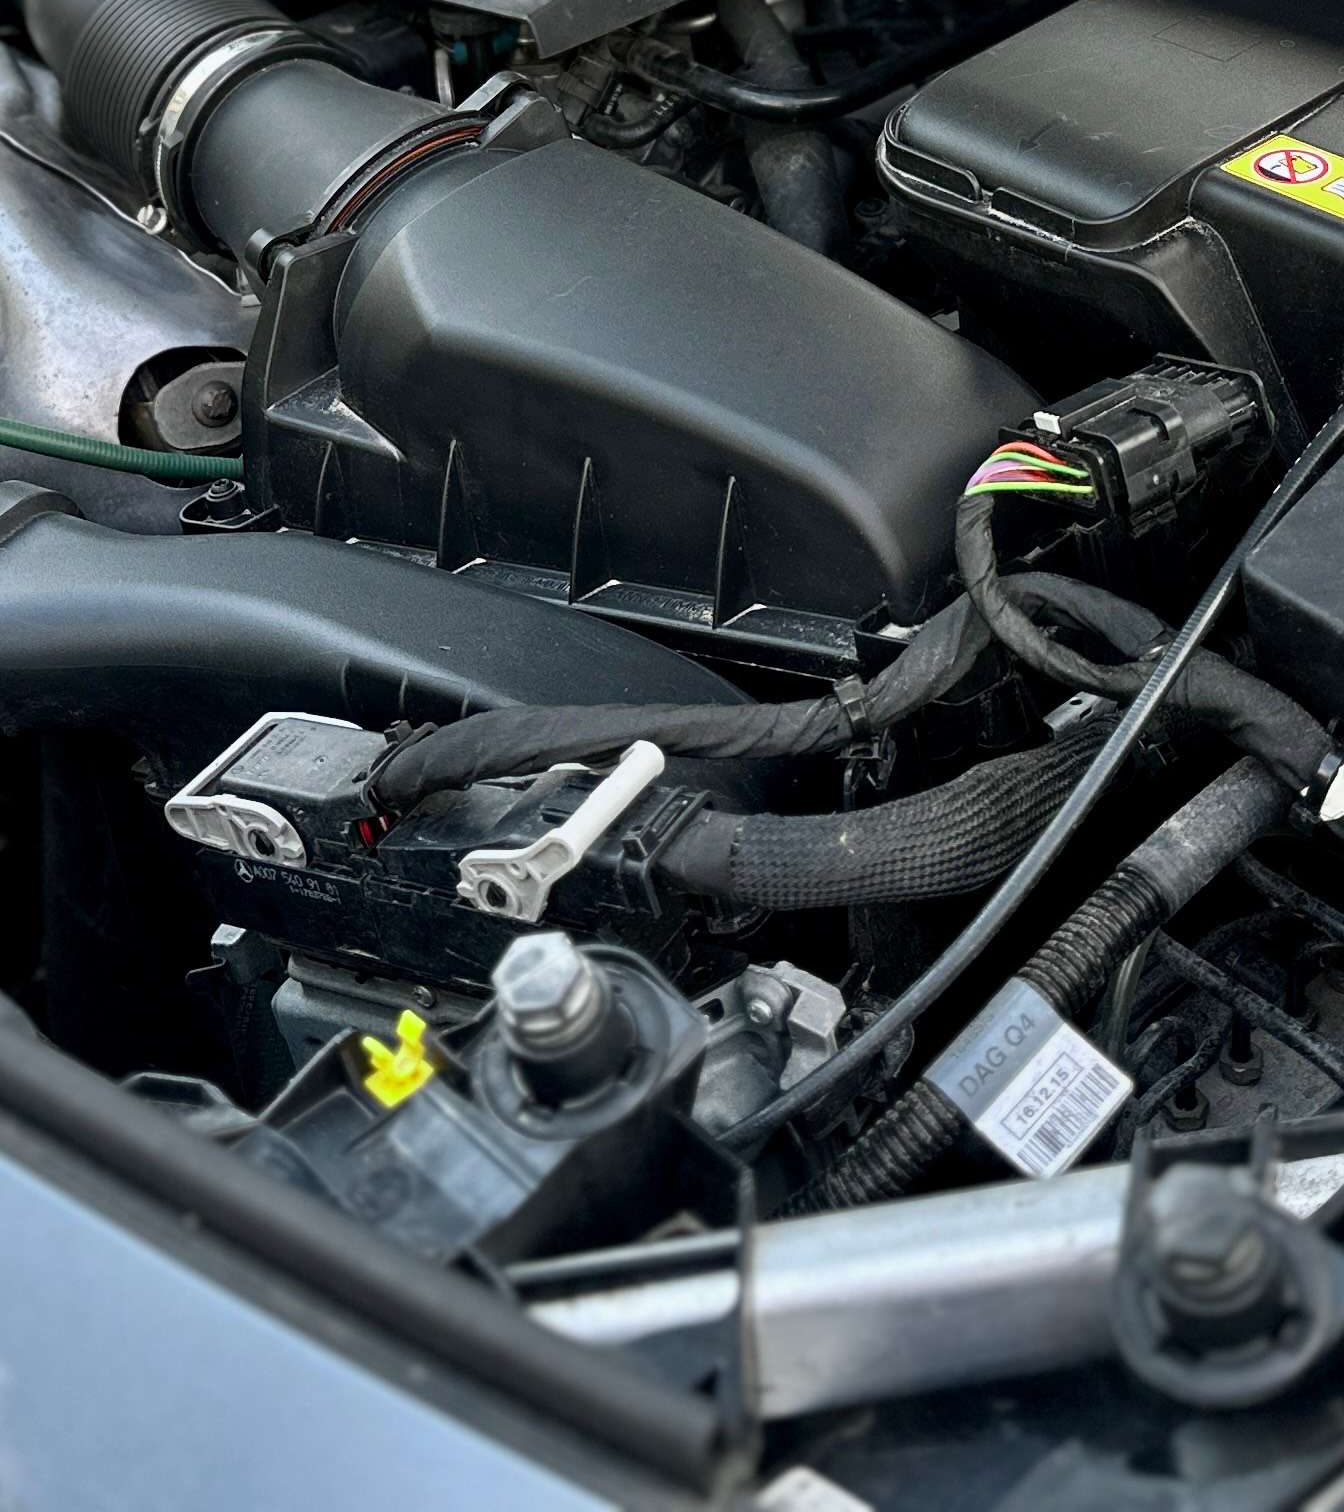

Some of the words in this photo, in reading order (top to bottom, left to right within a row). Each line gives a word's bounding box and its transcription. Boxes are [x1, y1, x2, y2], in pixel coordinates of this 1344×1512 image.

[957, 1046, 1006, 1099] DAG
[1004, 1012, 1036, 1048] Q4
[1016, 1067, 1071, 1126] 16.12.15
